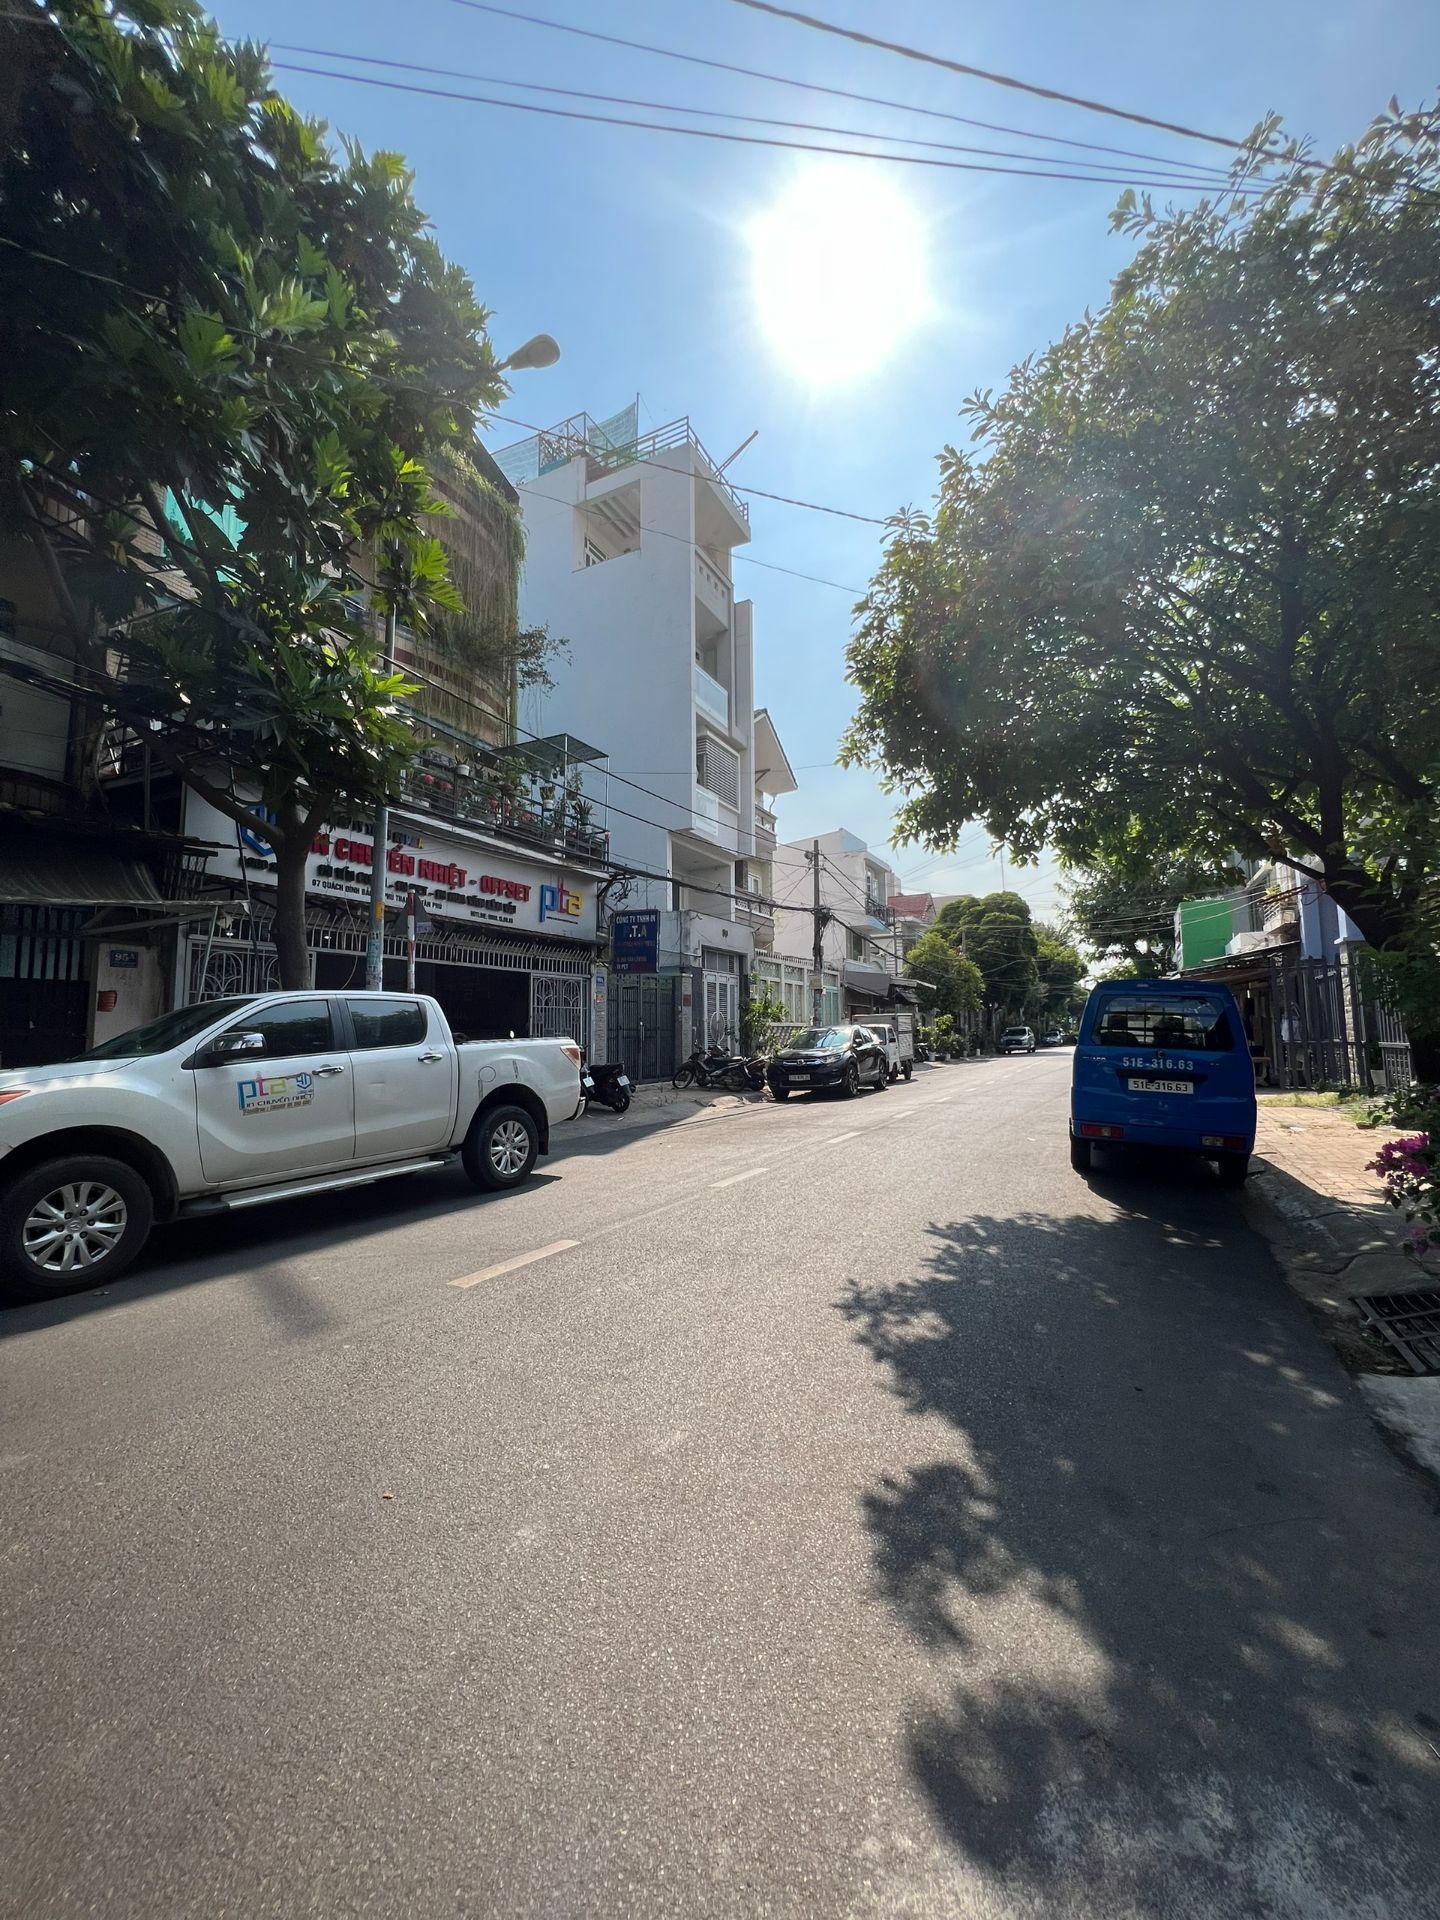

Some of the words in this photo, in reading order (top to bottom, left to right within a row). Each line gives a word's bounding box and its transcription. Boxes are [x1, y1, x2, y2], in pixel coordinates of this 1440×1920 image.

[322, 880, 344, 892] QUÁCH
[480, 874, 532, 902] OFFSET
[1122, 1056, 1194, 1071] 51E-316.63
